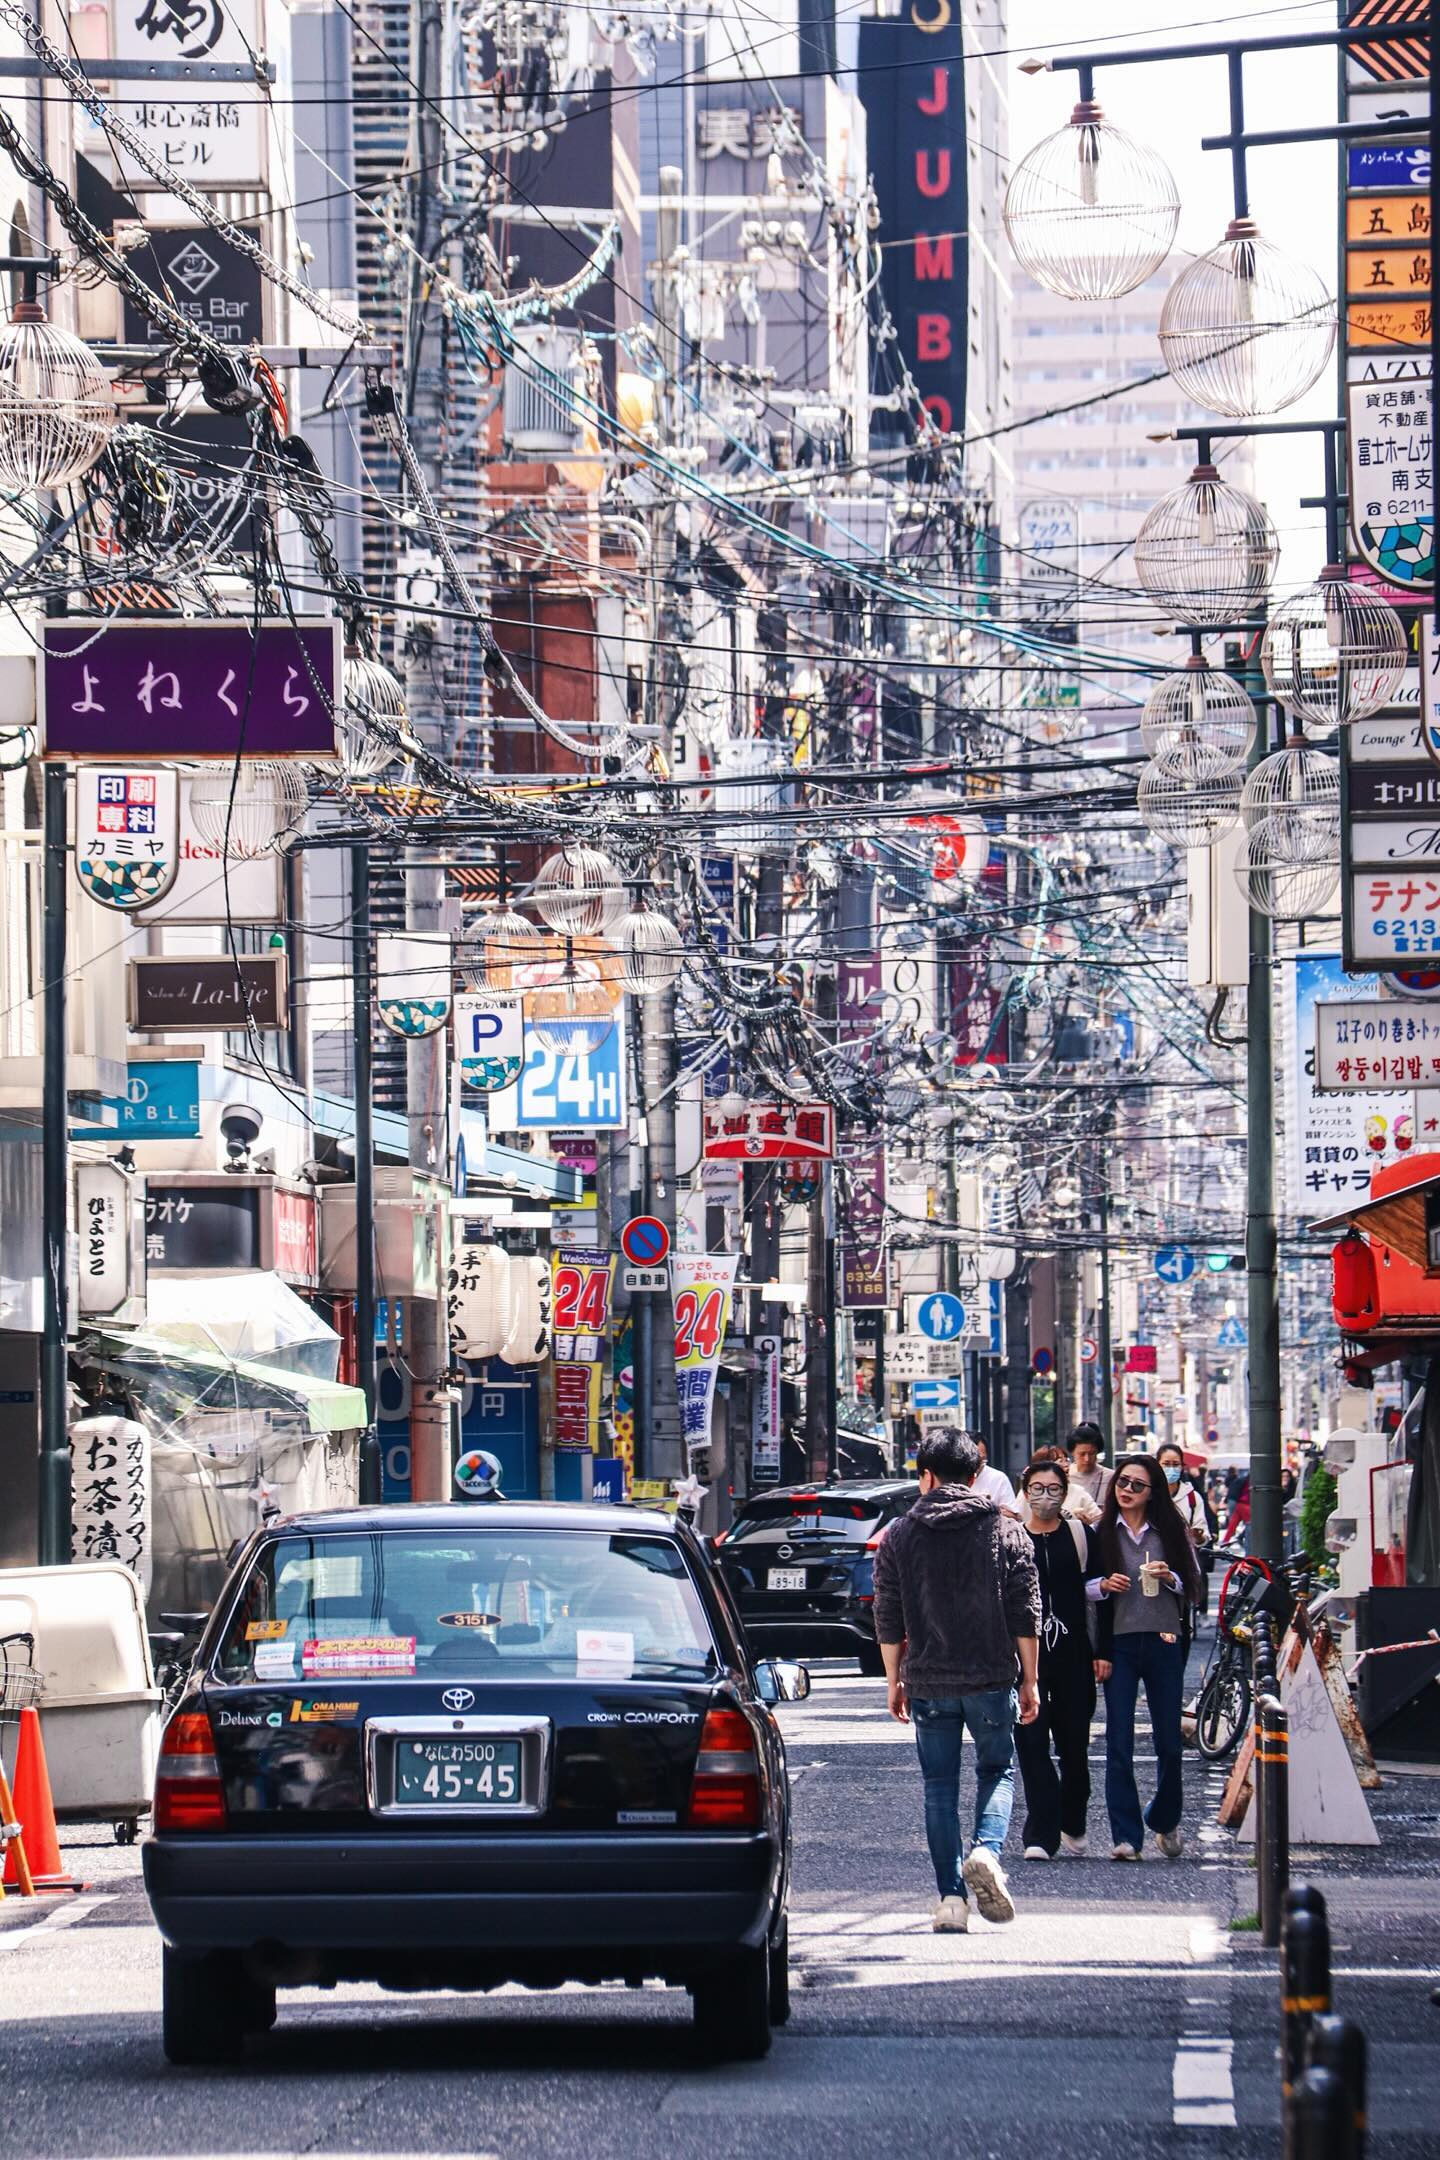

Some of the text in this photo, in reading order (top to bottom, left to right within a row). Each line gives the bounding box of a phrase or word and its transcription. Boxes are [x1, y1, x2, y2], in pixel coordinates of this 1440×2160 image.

[164, 141, 214, 165] ビル
[914, 67, 953, 434] JUMBO
[209, 298, 249, 318] Bar
[1356, 314, 1394, 325] カラオケ
[1379, 411, 1429, 428] 不動産
[1358, 434, 1433, 466] 富士ホームサ
[1391, 468, 1433, 491] 南支
[71, 660, 309, 717] よねくら
[1361, 734, 1406, 748] Lounge
[100, 777, 154, 802] 印刷
[1374, 779, 1440, 803] キャバ
[87, 839, 164, 857] カミヤ
[473, 1013, 503, 1054] P
[522, 1029, 617, 1119] 24H
[1305, 1146, 1359, 1163] 賃貸の
[461, 1250, 481, 1291] 手打
[561, 1253, 607, 1265] Welcome!
[676, 1261, 713, 1271] いつでも
[626, 1274, 666, 1287] 自動車
[554, 1268, 609, 1331] 24
[674, 1290, 723, 1360] 24
[83, 1435, 122, 1560] お茶漬
[273, 1622, 282, 1631] 2
[454, 1615, 488, 1626] 3151
[219, 1711, 262, 1726] Deluxe
[587, 1712, 699, 1724] CROWN COMFORT
[423, 1765, 515, 1798] 45-45
